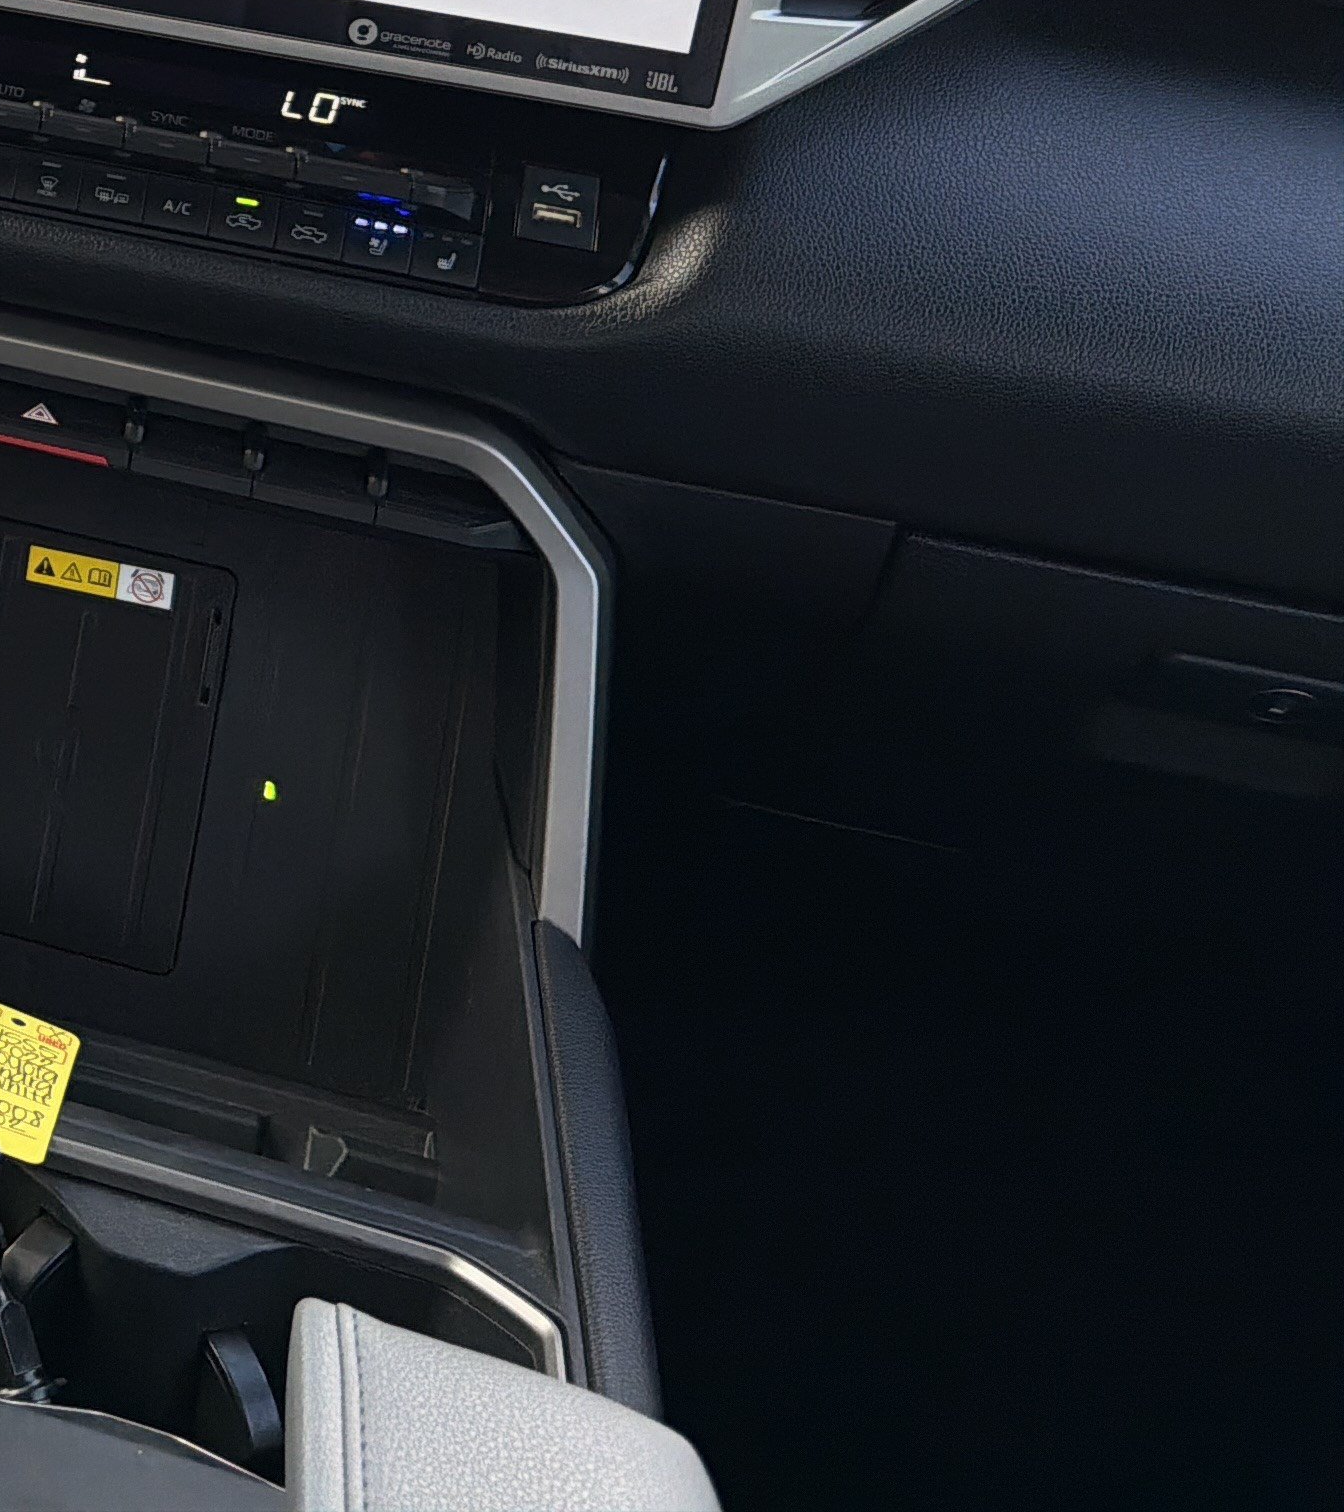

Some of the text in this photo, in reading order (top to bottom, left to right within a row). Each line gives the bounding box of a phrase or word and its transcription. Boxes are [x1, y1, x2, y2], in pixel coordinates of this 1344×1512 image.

[379, 30, 452, 52] gracenote
[486, 47, 523, 64] Radio
[646, 70, 679, 94] JBL
[340, 96, 367, 109] SYNC
[150, 110, 191, 128] SYNC
[232, 125, 276, 143] MODE
[163, 198, 192, 216] A/C
